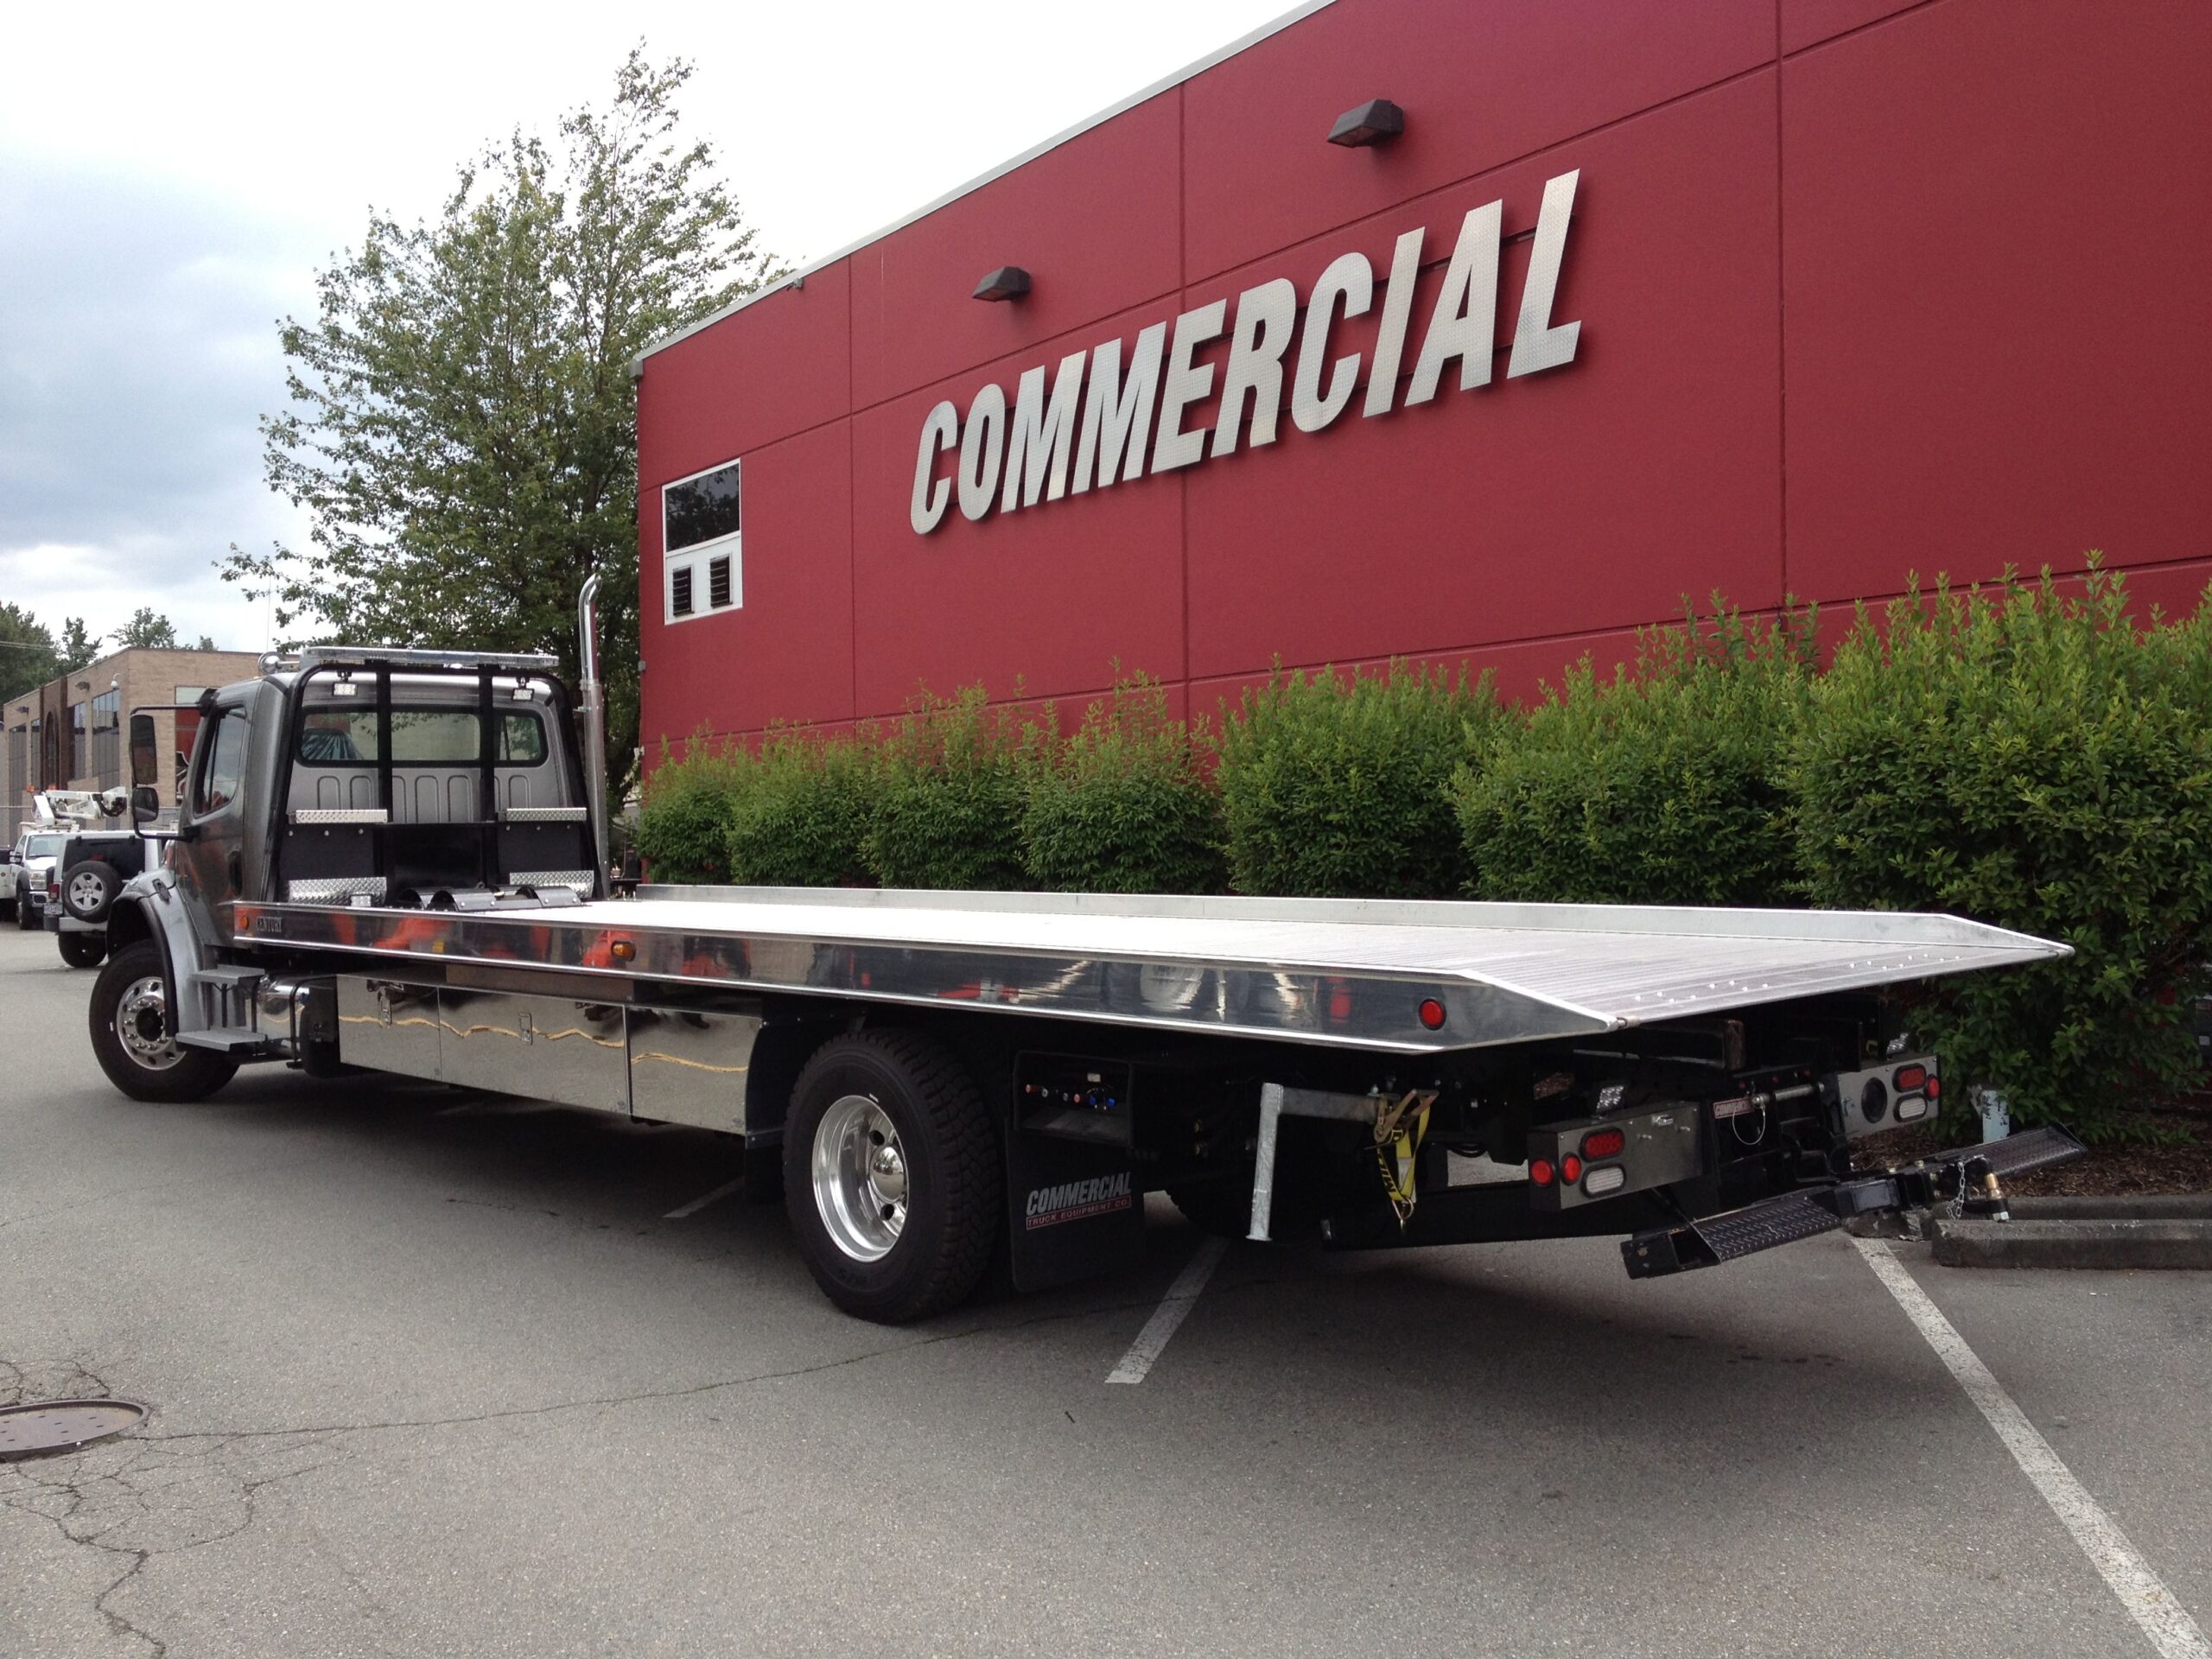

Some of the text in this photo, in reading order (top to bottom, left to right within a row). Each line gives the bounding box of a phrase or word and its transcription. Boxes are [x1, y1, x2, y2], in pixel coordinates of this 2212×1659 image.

[910, 168, 1582, 535] COMMERCIAL
[1027, 1172, 1131, 1216] COMMERCIAL
[1028, 1213, 1057, 1226] TRUCK
[1061, 1202, 1111, 1219] EQUIPMENT
